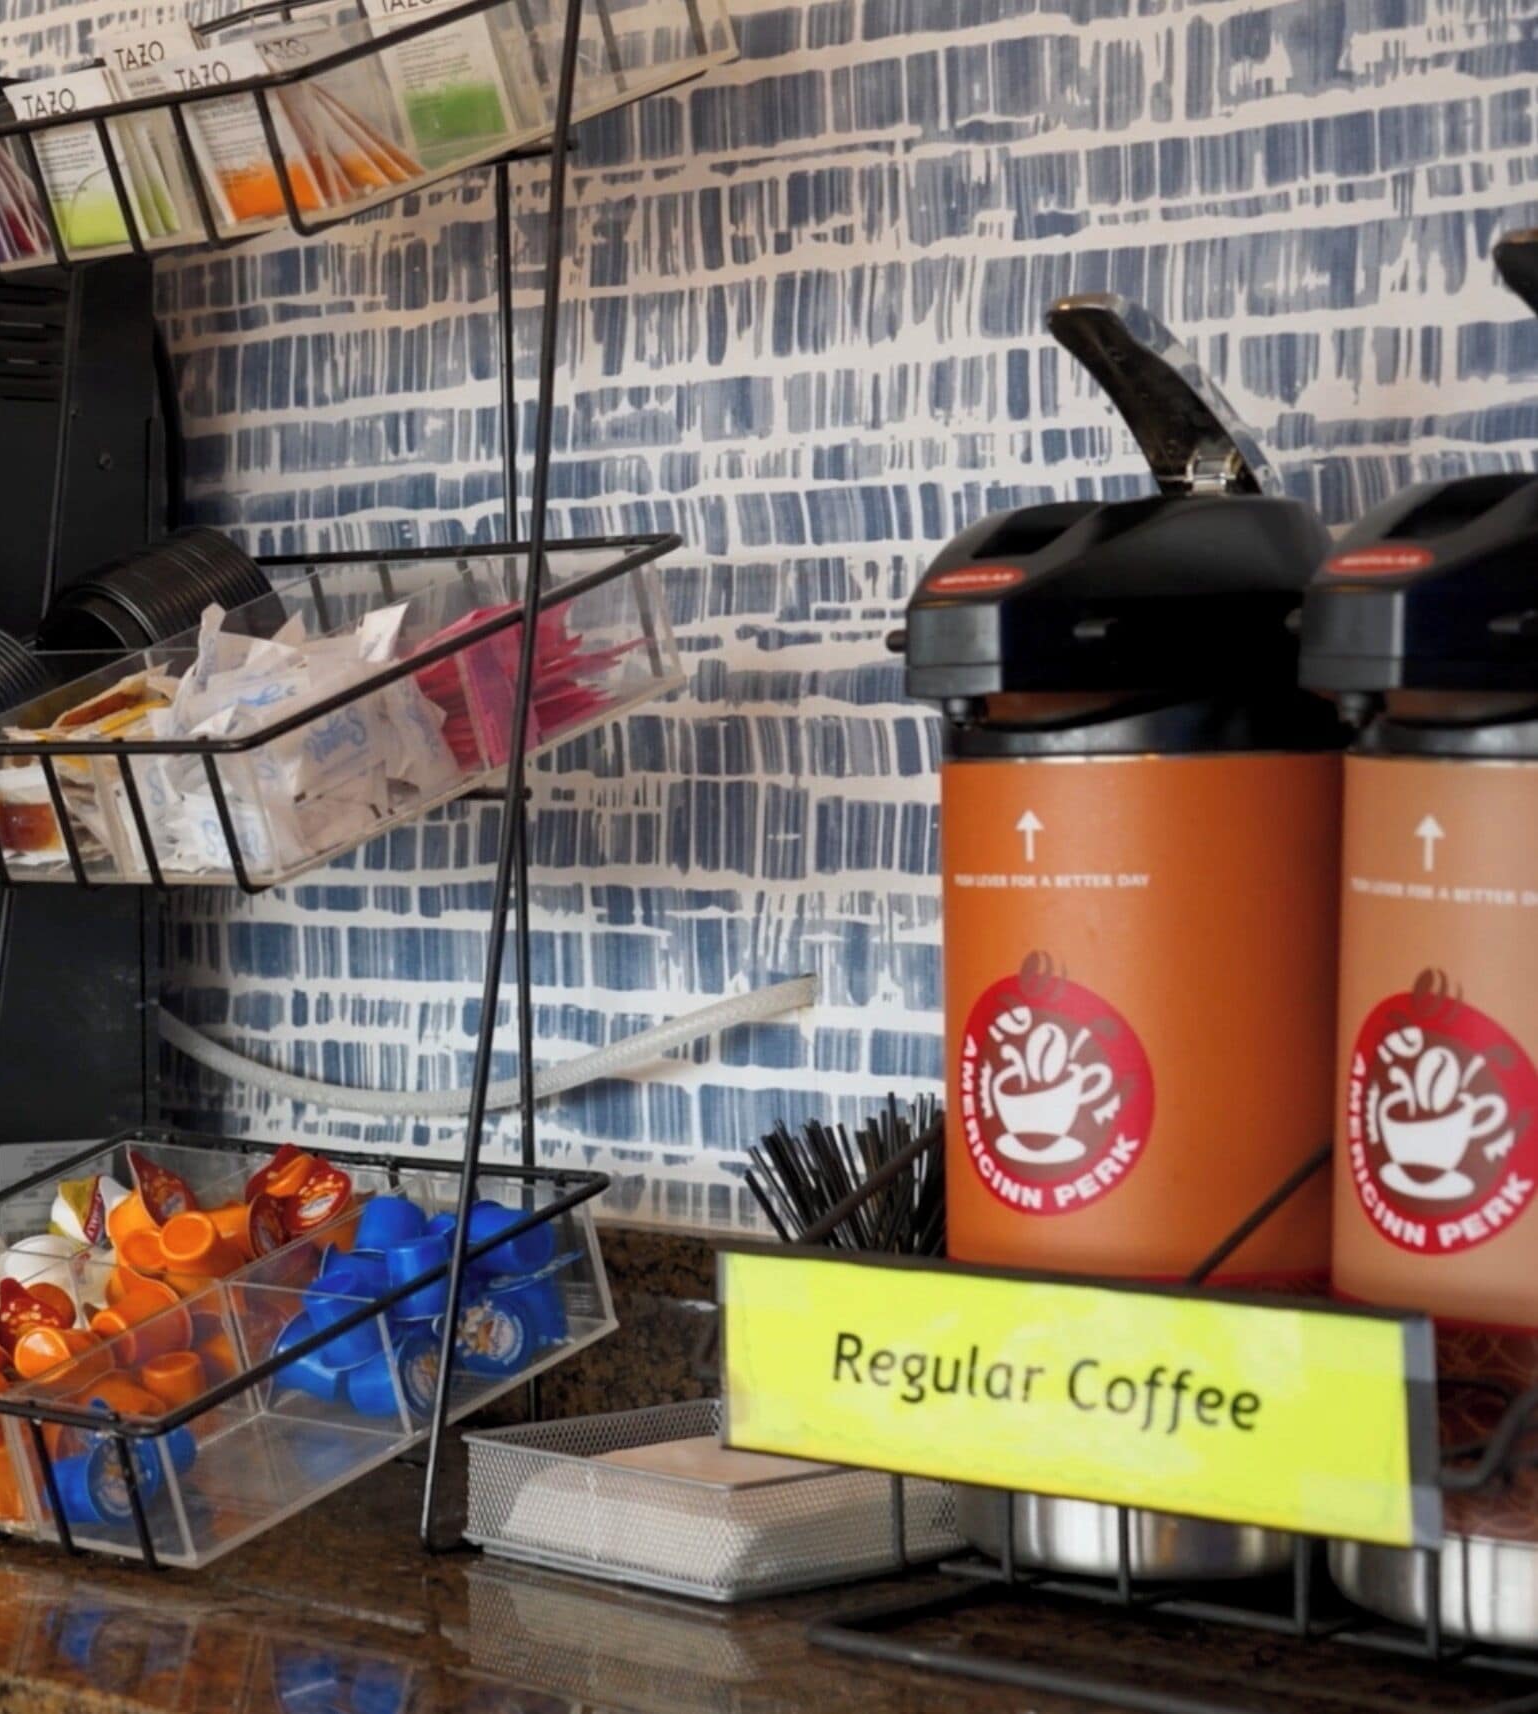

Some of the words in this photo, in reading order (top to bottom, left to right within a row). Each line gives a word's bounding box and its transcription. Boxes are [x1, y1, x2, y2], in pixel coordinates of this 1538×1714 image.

[114, 41, 165, 72] TAZO
[174, 61, 232, 90] TAZO
[21, 88, 76, 120] TAZO
[1039, 874, 1052, 888] A
[1055, 874, 1112, 889] BETTER
[1117, 874, 1150, 889] DAY
[962, 1034, 1043, 1210] AMERICINN
[1053, 1132, 1140, 1209] PERK
[1349, 1052, 1427, 1248] AMERICINN
[1436, 1171, 1534, 1249] PERK
[831, 1331, 1045, 1405] Regular
[1067, 1357, 1262, 1436] Coffee
